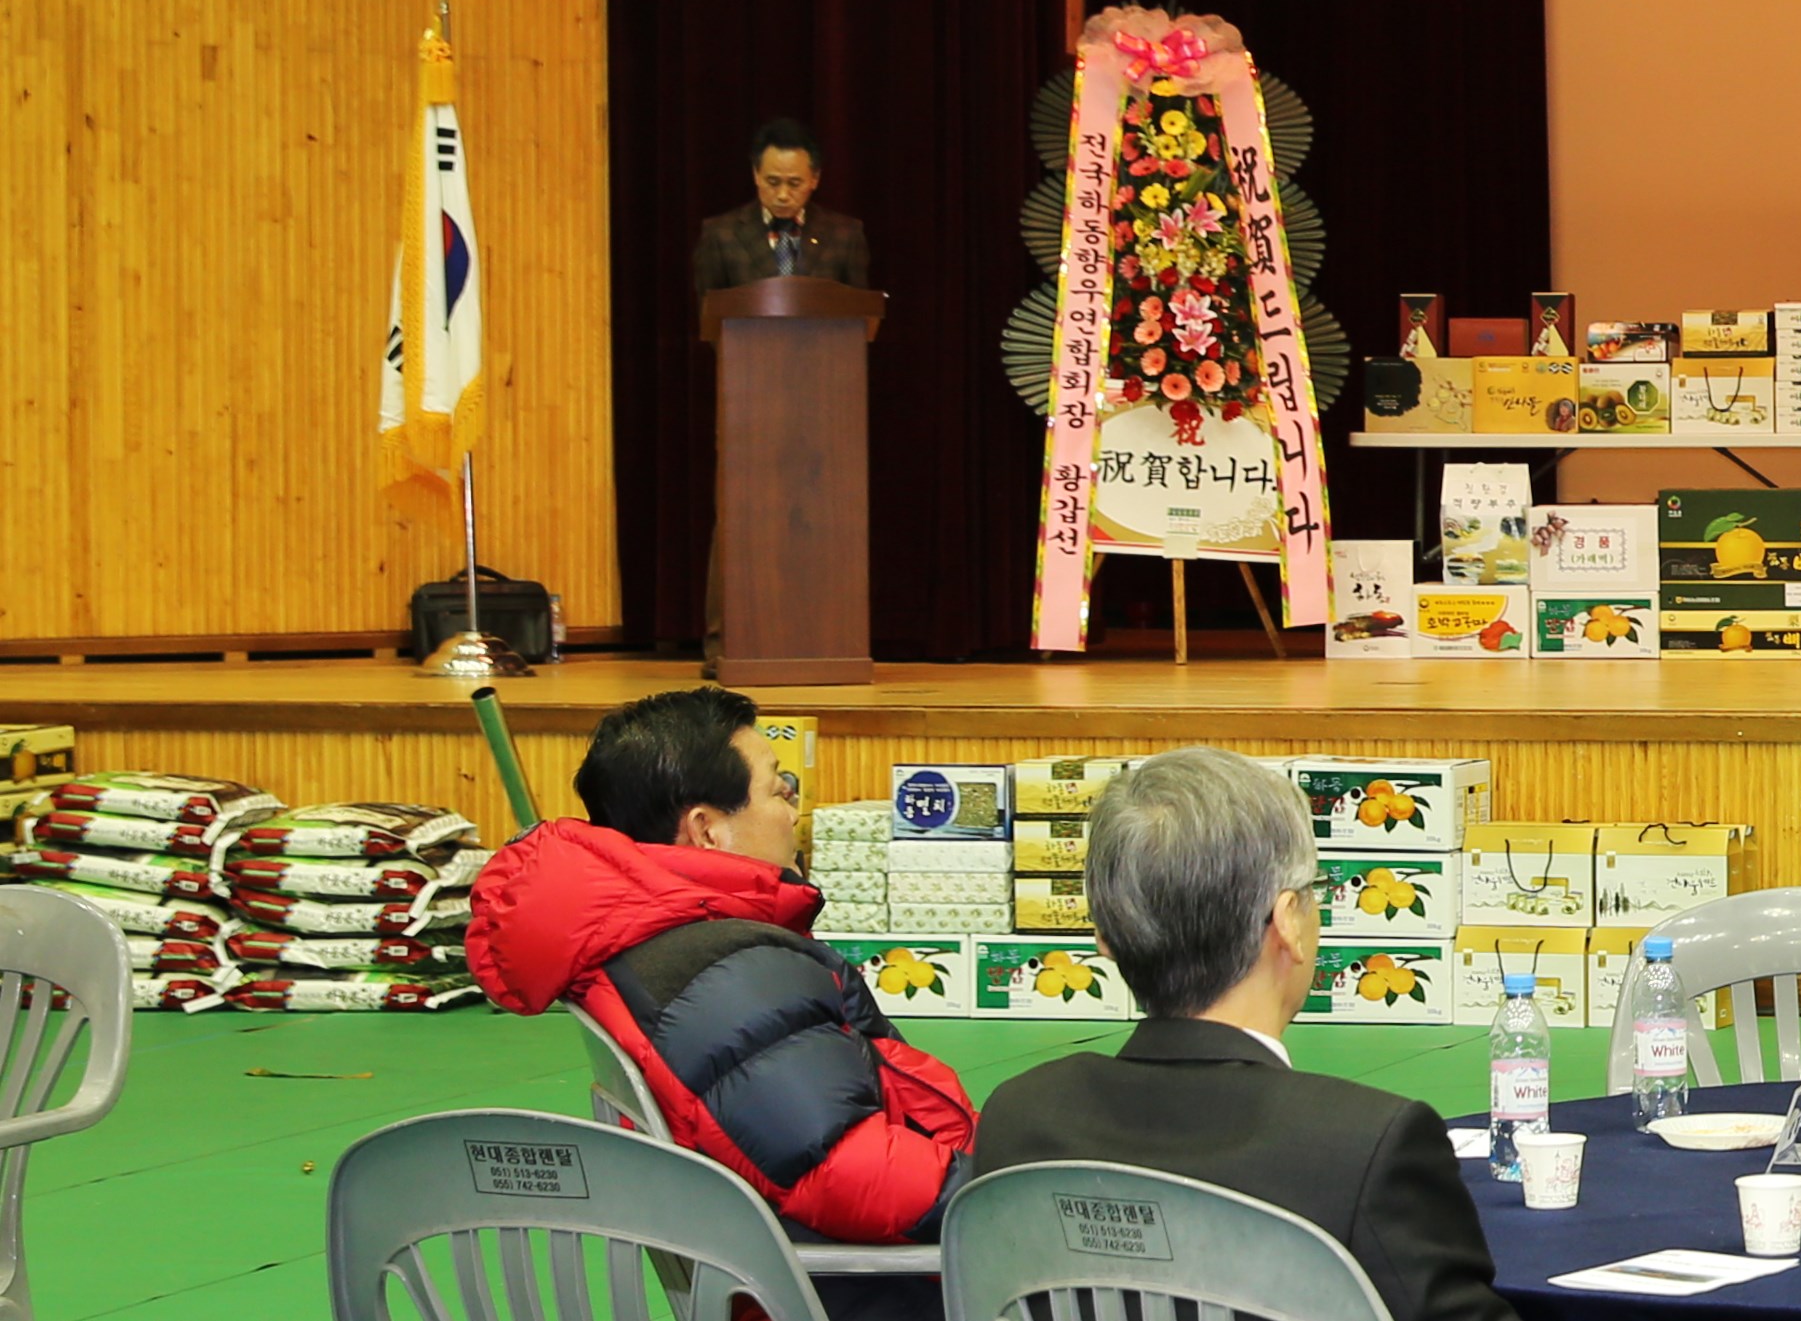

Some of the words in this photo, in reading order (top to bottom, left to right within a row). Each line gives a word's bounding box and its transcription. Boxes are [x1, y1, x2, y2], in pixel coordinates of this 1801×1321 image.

[1062, 133, 1109, 430] 전국하동향우연합회장
[1652, 1044, 1685, 1058] White
[1514, 1085, 1547, 1099] White
[470, 1145, 573, 1167] 현대종합렌탈
[1060, 1199, 1155, 1225] 현대종합렌탈
